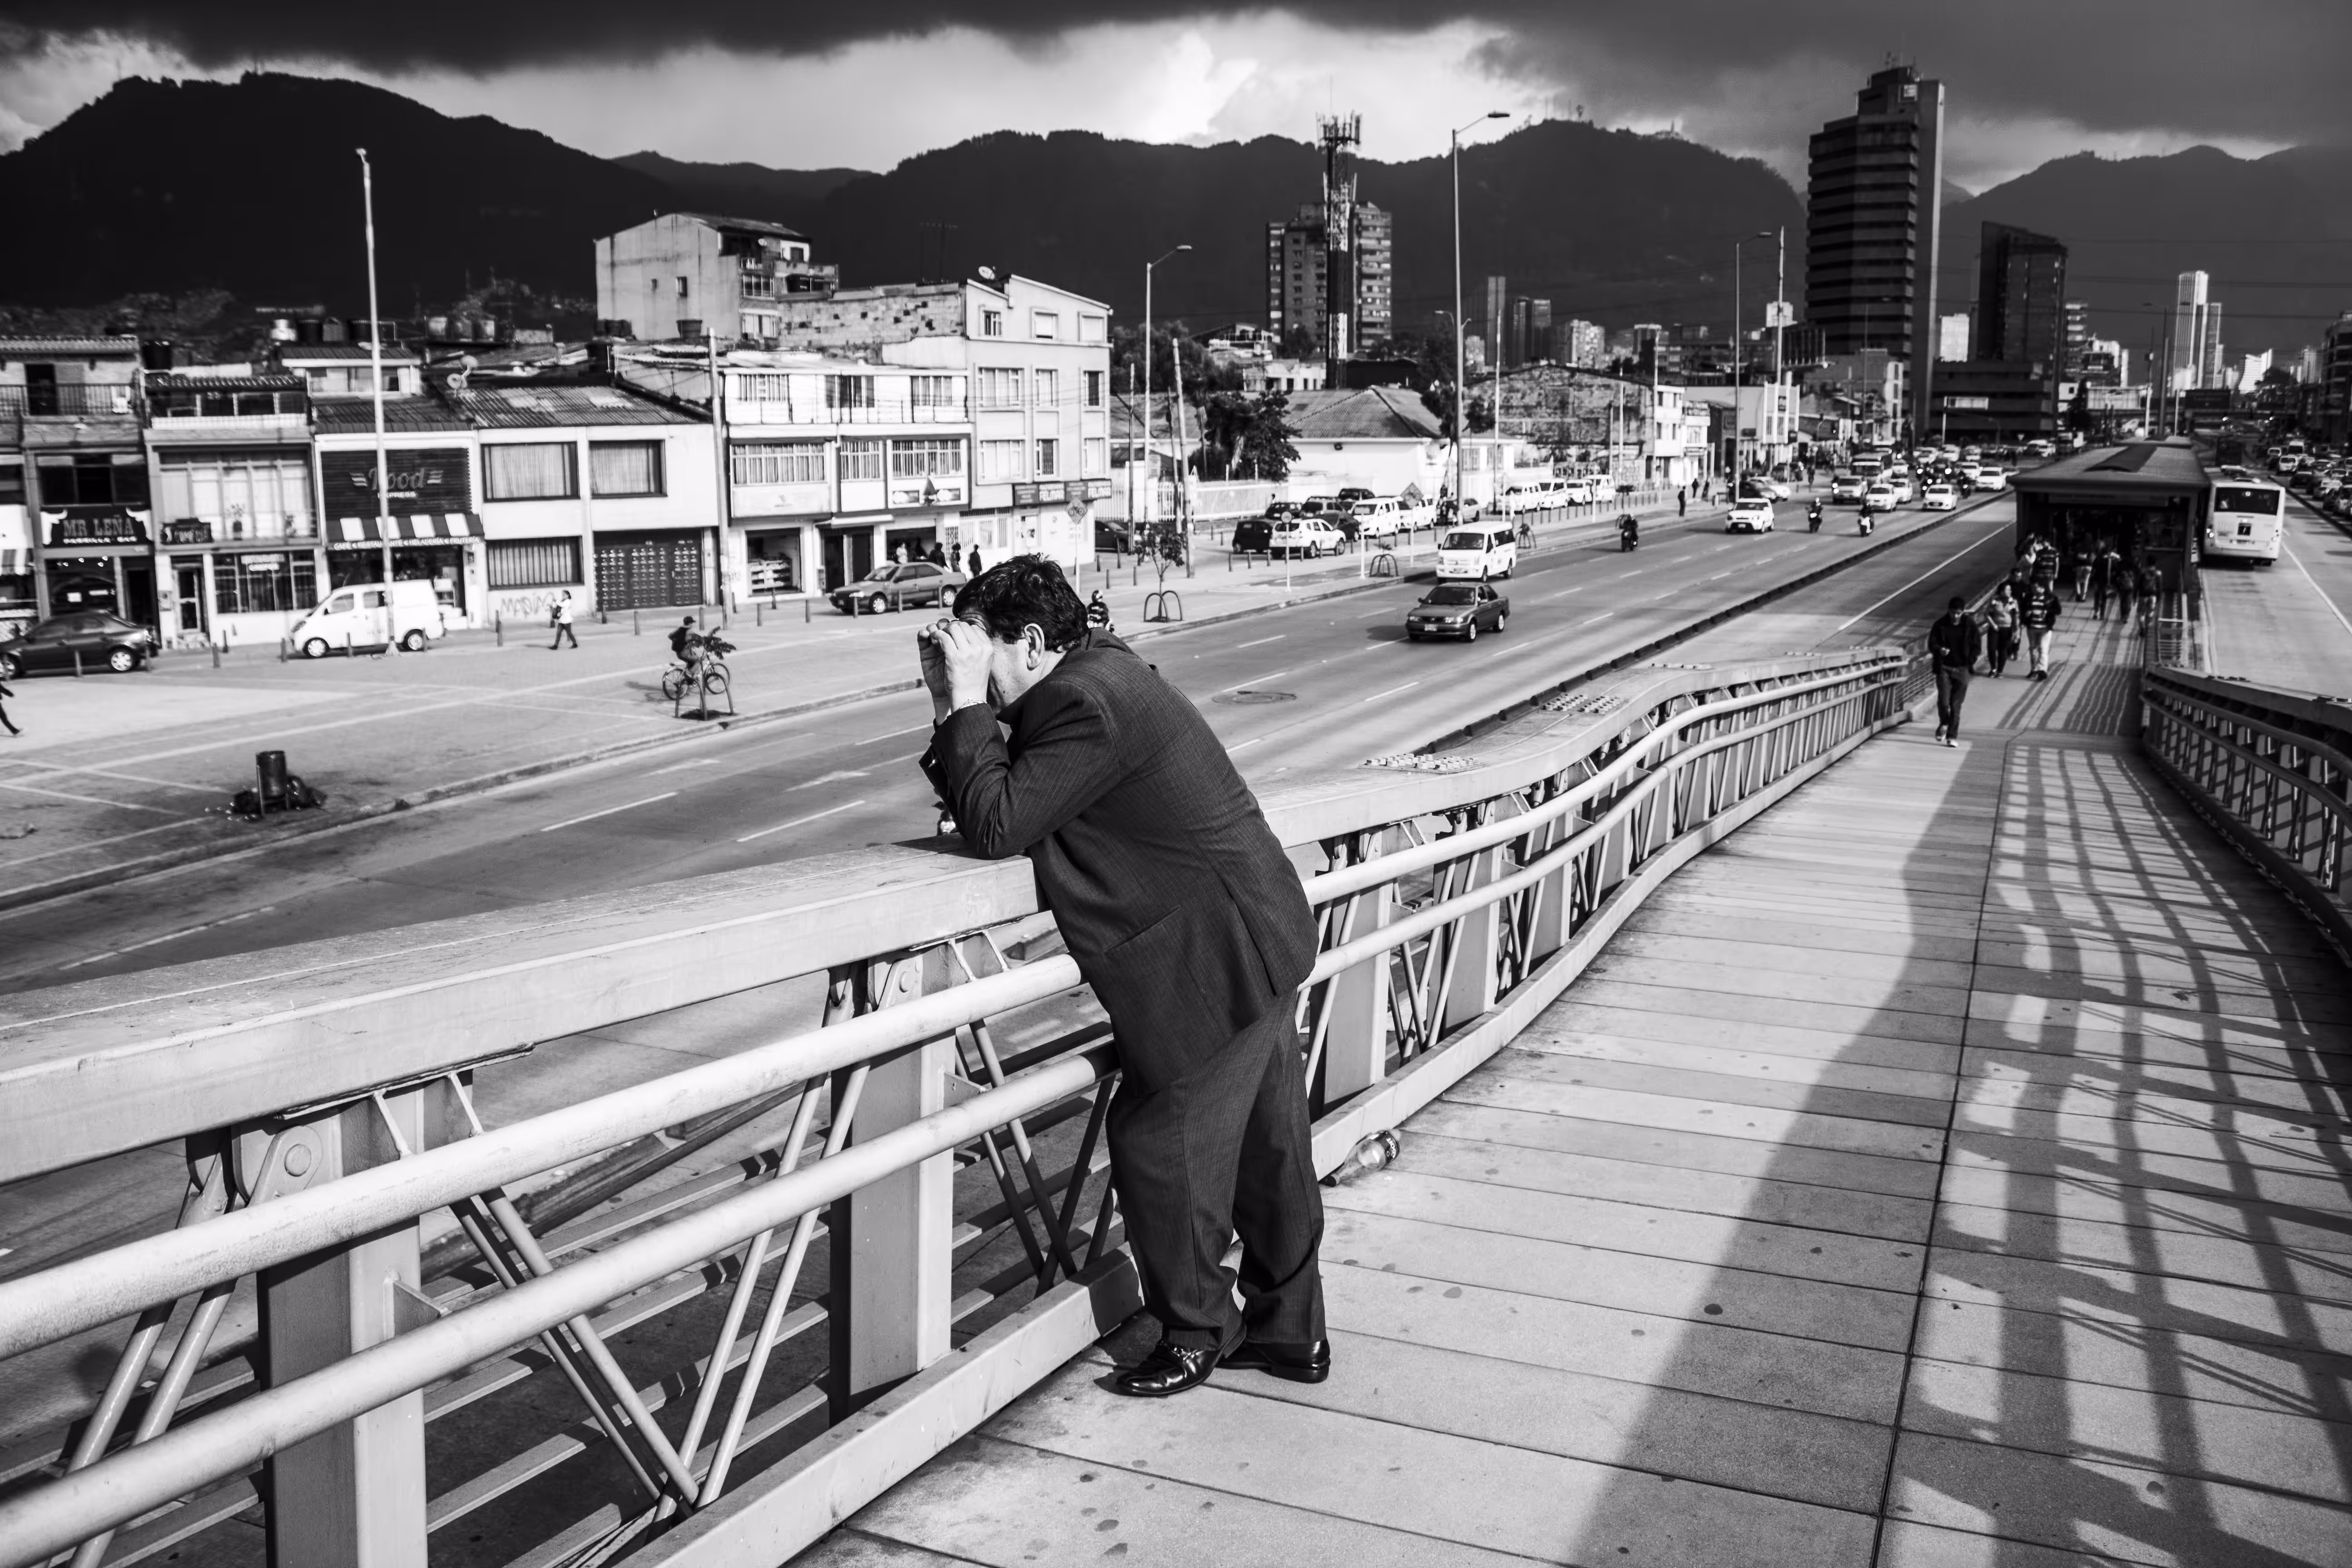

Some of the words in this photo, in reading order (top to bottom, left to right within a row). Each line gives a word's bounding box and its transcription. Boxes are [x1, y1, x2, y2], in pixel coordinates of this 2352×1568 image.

[63, 519, 88, 537] MR
[93, 514, 134, 536] LEÑA
[357, 539, 404, 549] RESTAUANTE
